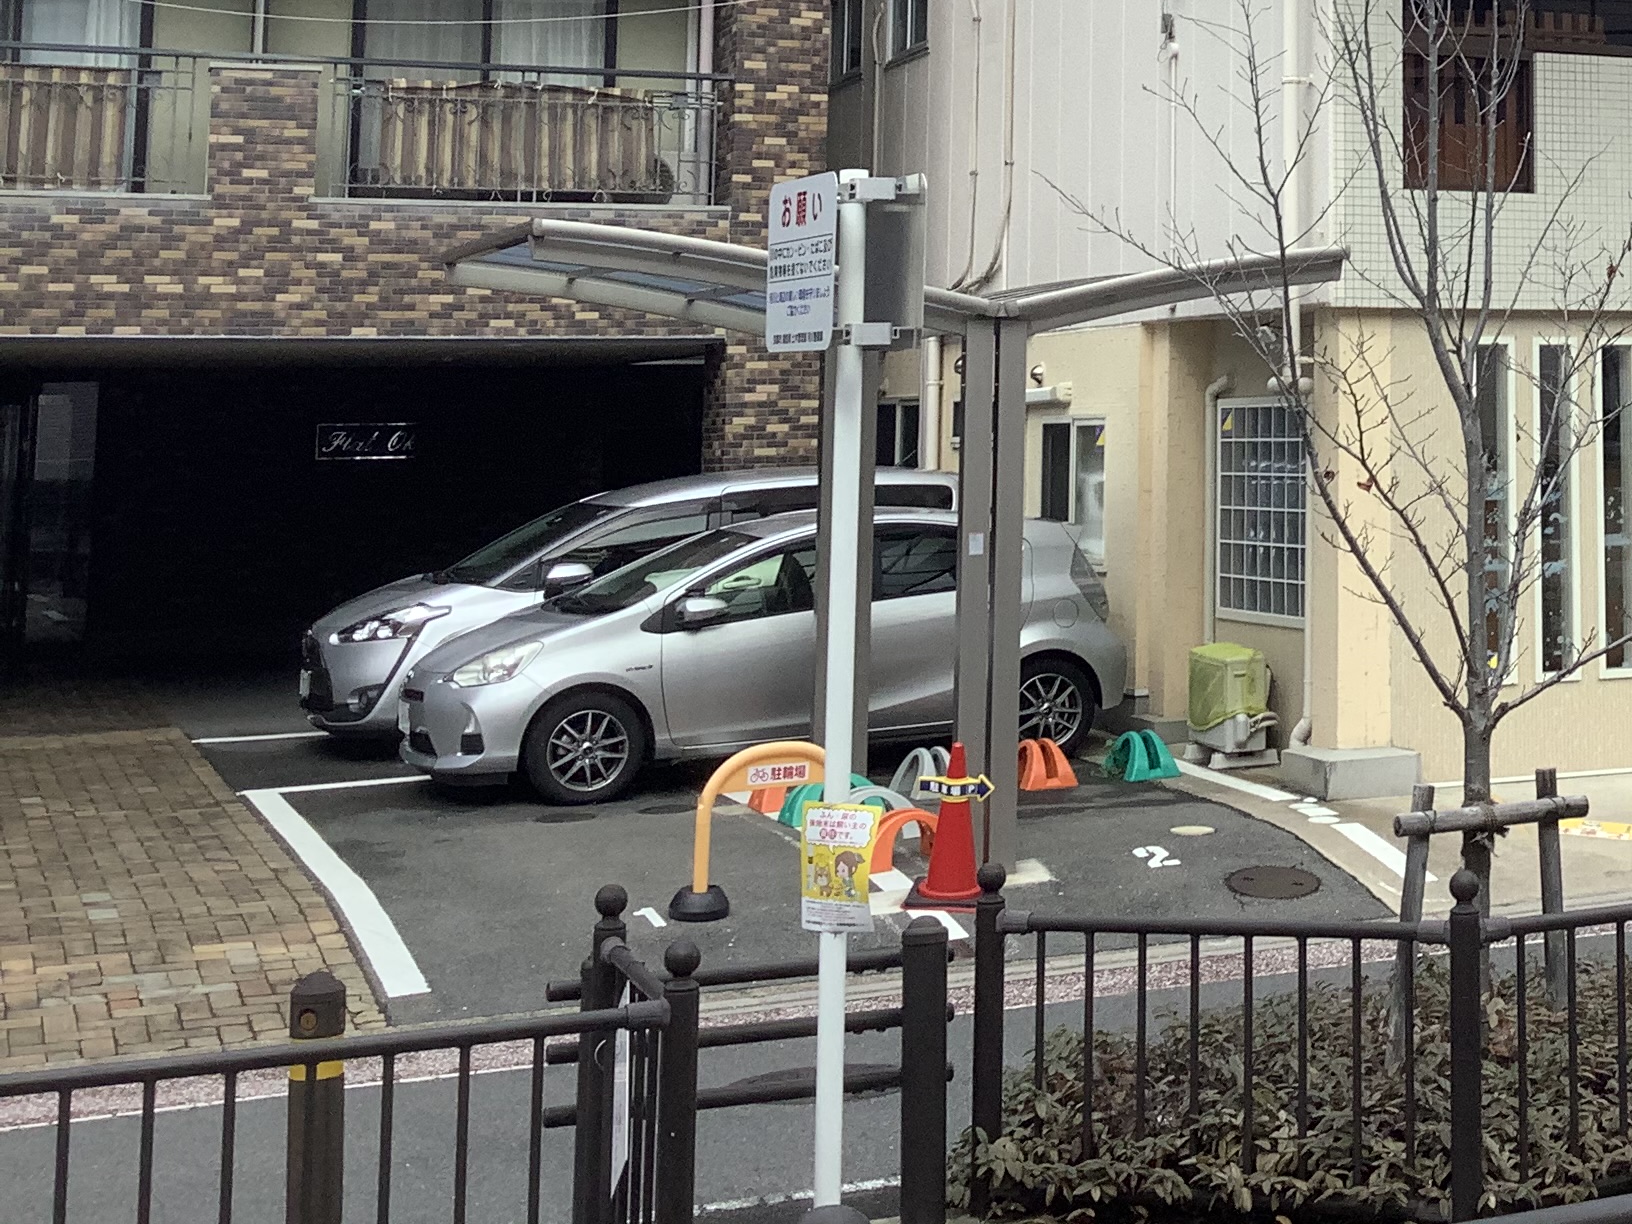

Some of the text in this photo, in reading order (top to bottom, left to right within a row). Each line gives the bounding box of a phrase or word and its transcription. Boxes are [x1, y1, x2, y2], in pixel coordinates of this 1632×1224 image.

[781, 191, 822, 227] お願い
[770, 765, 806, 780] 駐輪場
[1132, 845, 1181, 868] 2
